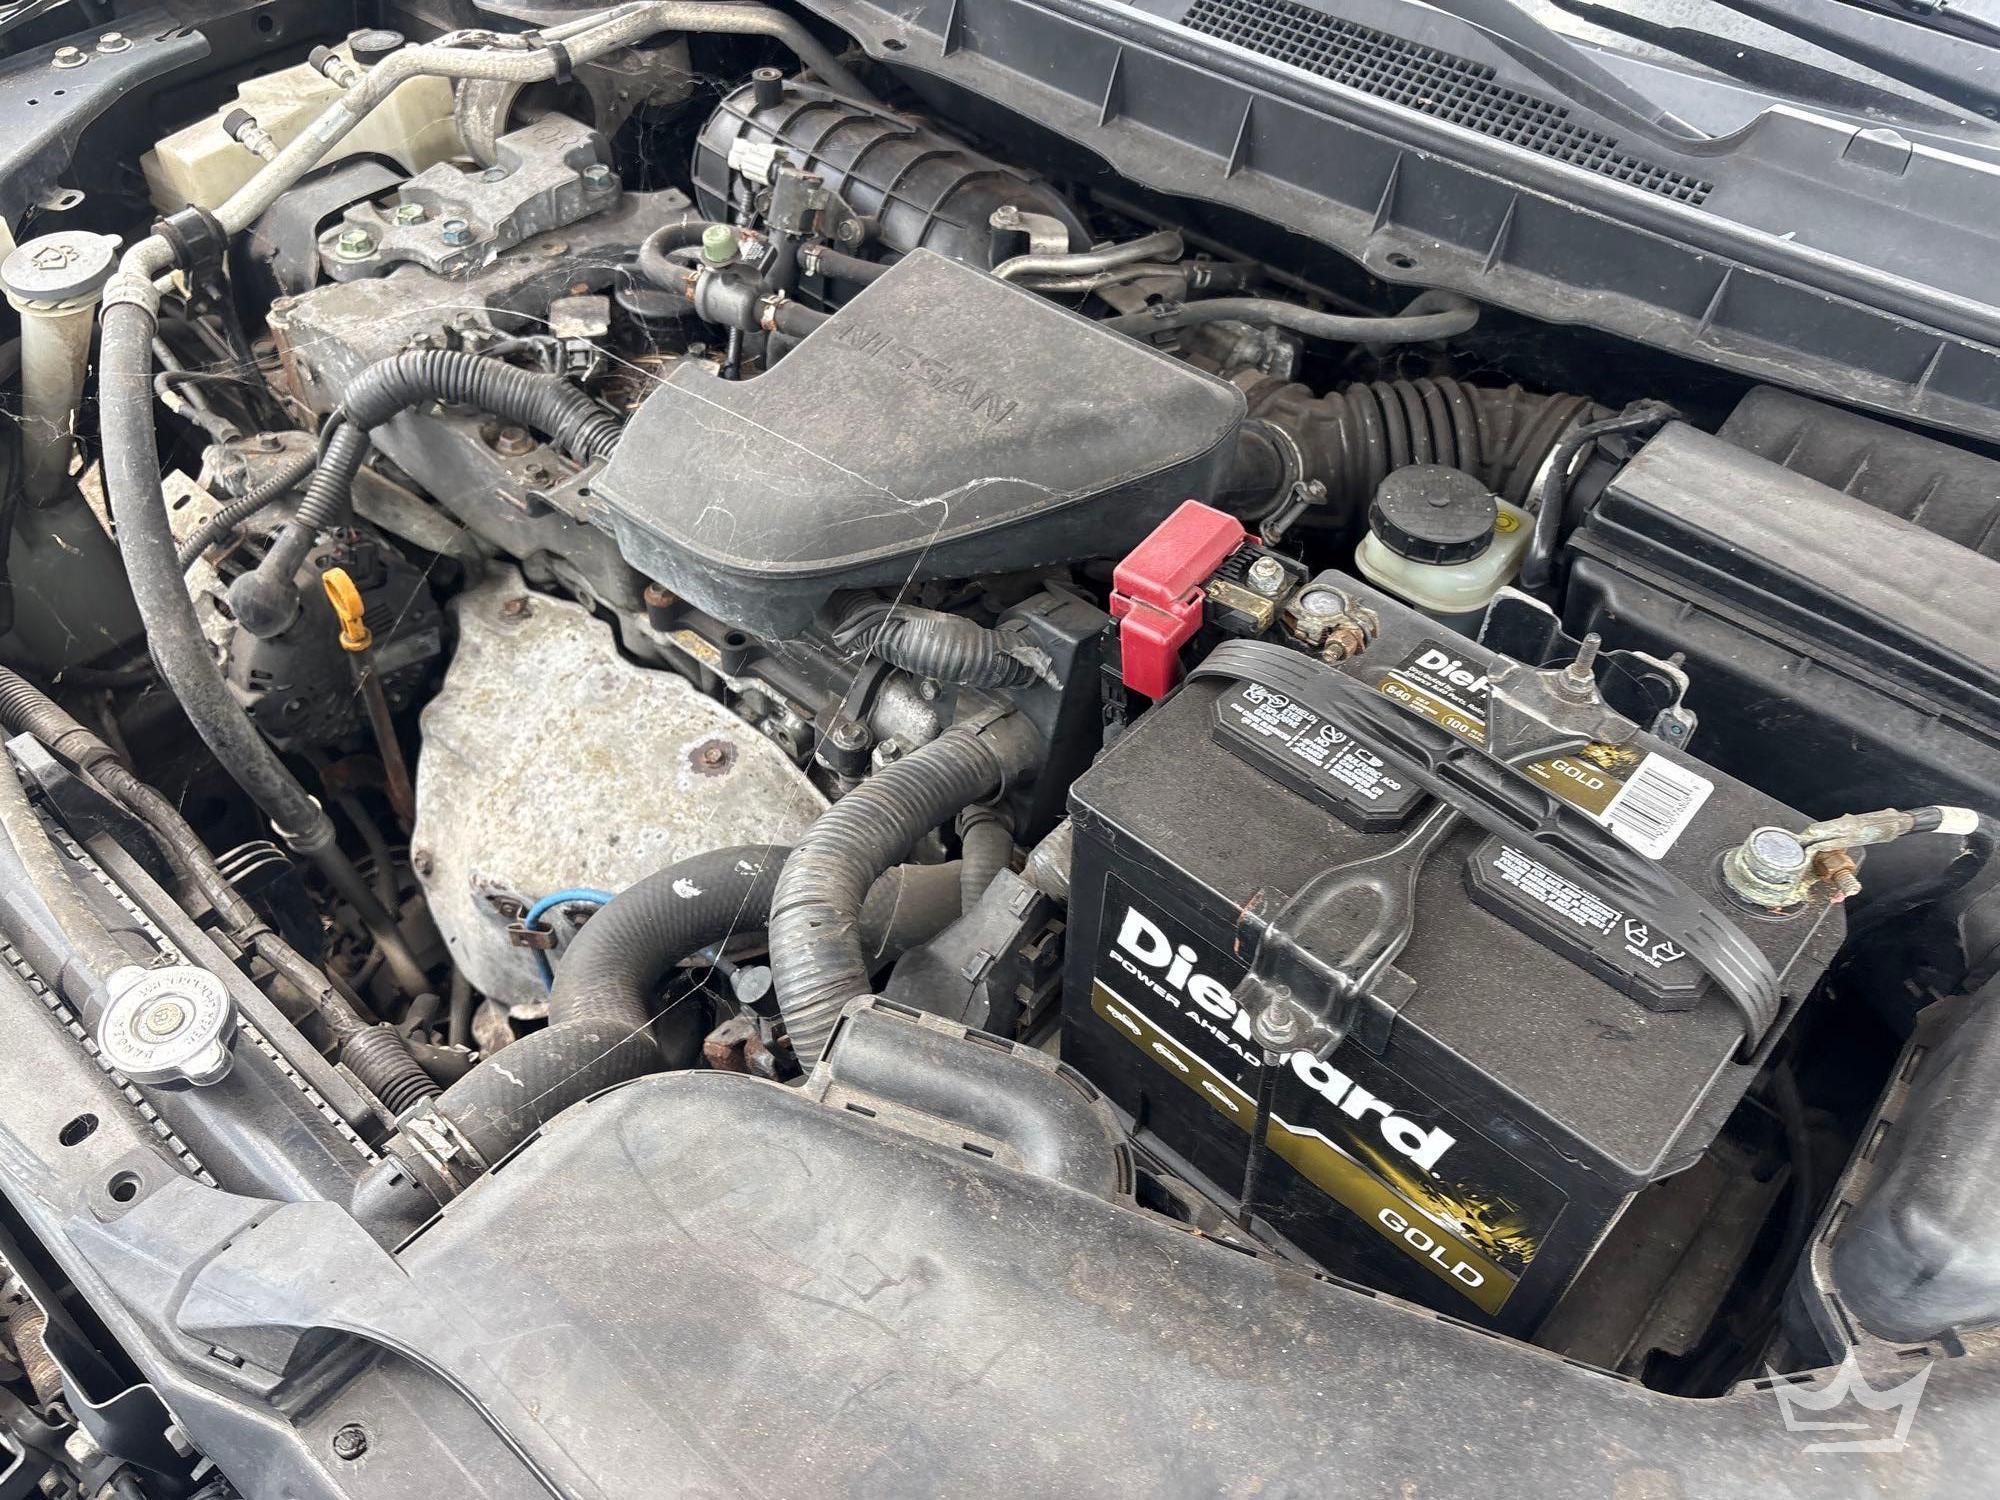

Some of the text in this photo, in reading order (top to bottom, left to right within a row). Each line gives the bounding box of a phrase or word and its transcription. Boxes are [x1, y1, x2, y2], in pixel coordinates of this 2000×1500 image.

[838, 323, 1020, 424] NISSAN
[1402, 670, 1432, 686] Advance
[1431, 684, 1449, 694] Auto
[1408, 666, 1446, 686] Distributed
[1254, 709, 1279, 725] GASES
[1259, 703, 1299, 728] EXPLOSIVE
[1282, 709, 1303, 721] EYES
[1287, 704, 1316, 722] SHIELD
[1446, 715, 1469, 732] 100
[1313, 736, 1330, 747] NO
[1343, 754, 1401, 790] SULFURIC ACID
[1551, 760, 1604, 790] GOLD
[1625, 944, 1662, 968] RECYCLE
[1109, 950, 1263, 1067] POWER AHEAD
[1378, 1208, 1484, 1287] GOLD
